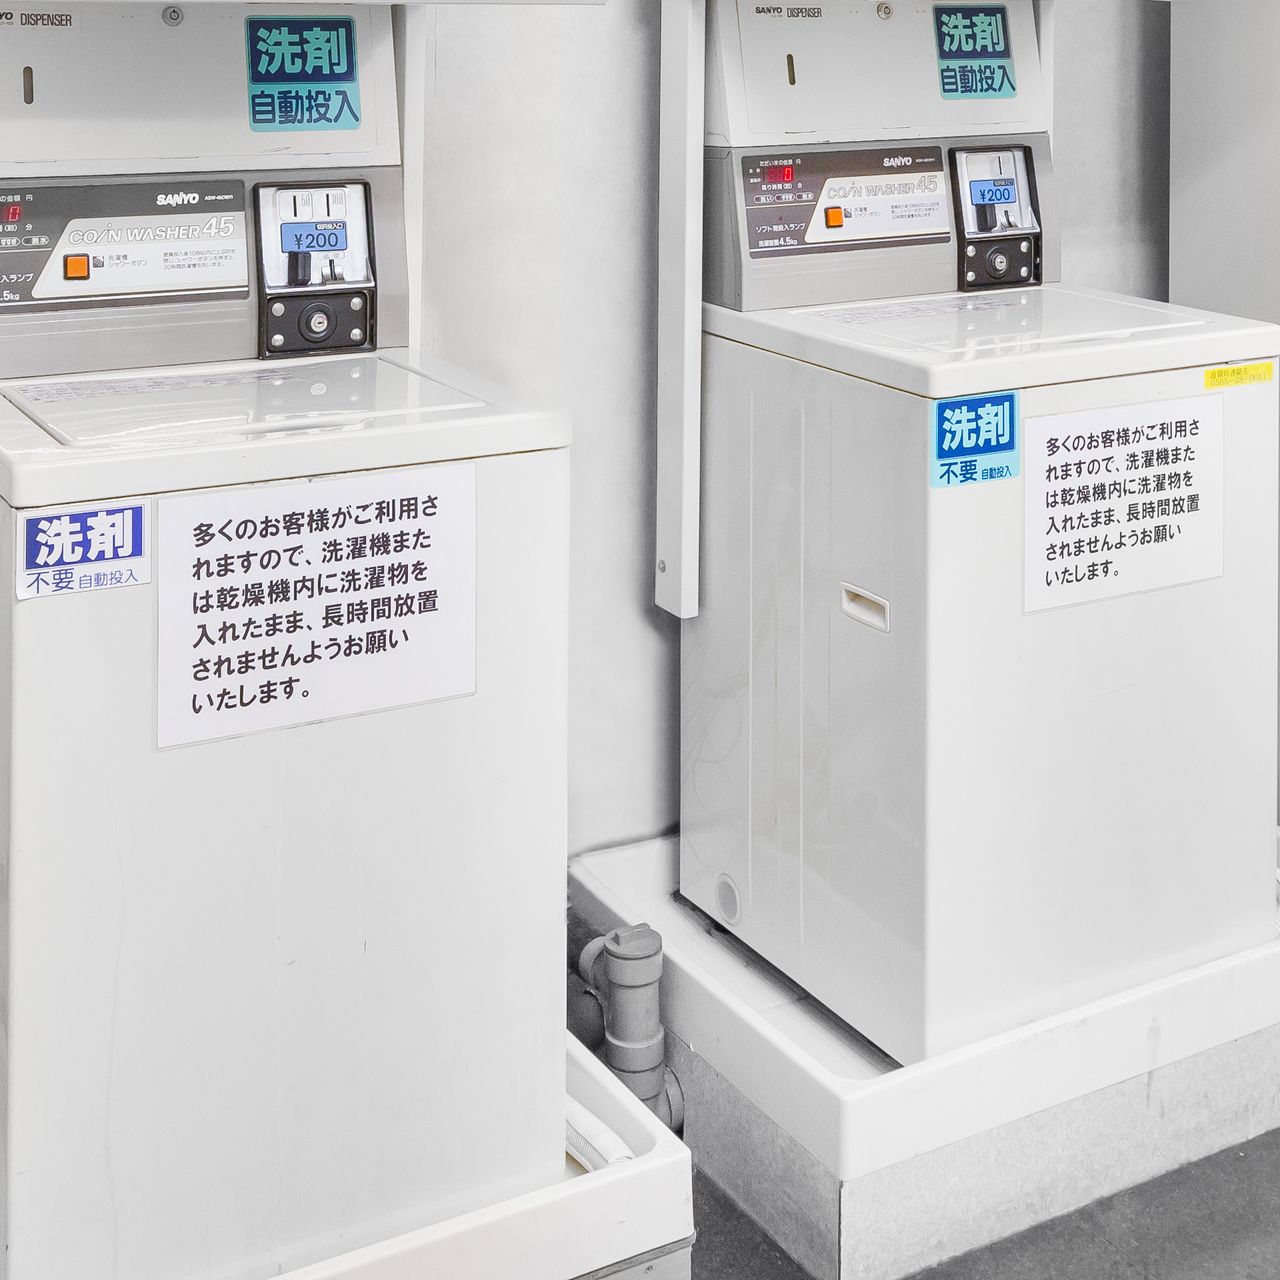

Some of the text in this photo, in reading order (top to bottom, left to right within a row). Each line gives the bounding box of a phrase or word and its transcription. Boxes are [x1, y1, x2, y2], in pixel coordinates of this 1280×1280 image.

[20, 12, 72, 27] DISPENSER
[755, 5, 782, 15] SANYO
[256, 26, 348, 75] 洗剤
[940, 12, 1006, 53] 洗剤
[940, 64, 1016, 94] 自動投入
[251, 89, 360, 125] 自動投入
[784, 167, 792, 181] 0
[883, 156, 913, 168] SANYO
[25, 194, 33, 202] 円
[156, 192, 200, 207] SANYO
[866, 182, 916, 198] WASHER
[915, 175, 938, 193] 45
[979, 188, 1011, 202] ¥200
[25, 223, 33, 231] 分
[126, 225, 201, 241] WASHER
[201, 216, 235, 238] 45
[294, 232, 339, 250] ¥200
[941, 401, 1011, 452] 洗剤
[1045, 418, 1201, 457] 多くのお客様がご利用さ
[939, 459, 1012, 485] 不要 自動投入
[1045, 444, 1196, 483] れますので、洗濯機また
[1045, 469, 1194, 510] は乾燥機内に洗濯物を
[192, 494, 440, 548] 多くのお客様がご利用さ
[1045, 493, 1201, 536] 入れたまま、長時間放置
[34, 508, 134, 567] 洗剤
[191, 528, 433, 581] れますので、洗濯機また
[1045, 523, 1182, 562] されませんようお願い
[26, 568, 139, 595] 不要 自動投入
[191, 560, 429, 615] は乾燥機内に洗濯物を
[1045, 559, 1120, 588] いたします。
[192, 589, 440, 649] 入れたまま、長時間放置
[191, 626, 410, 682] されませんようお願い
[191, 679, 312, 716] いたします。
